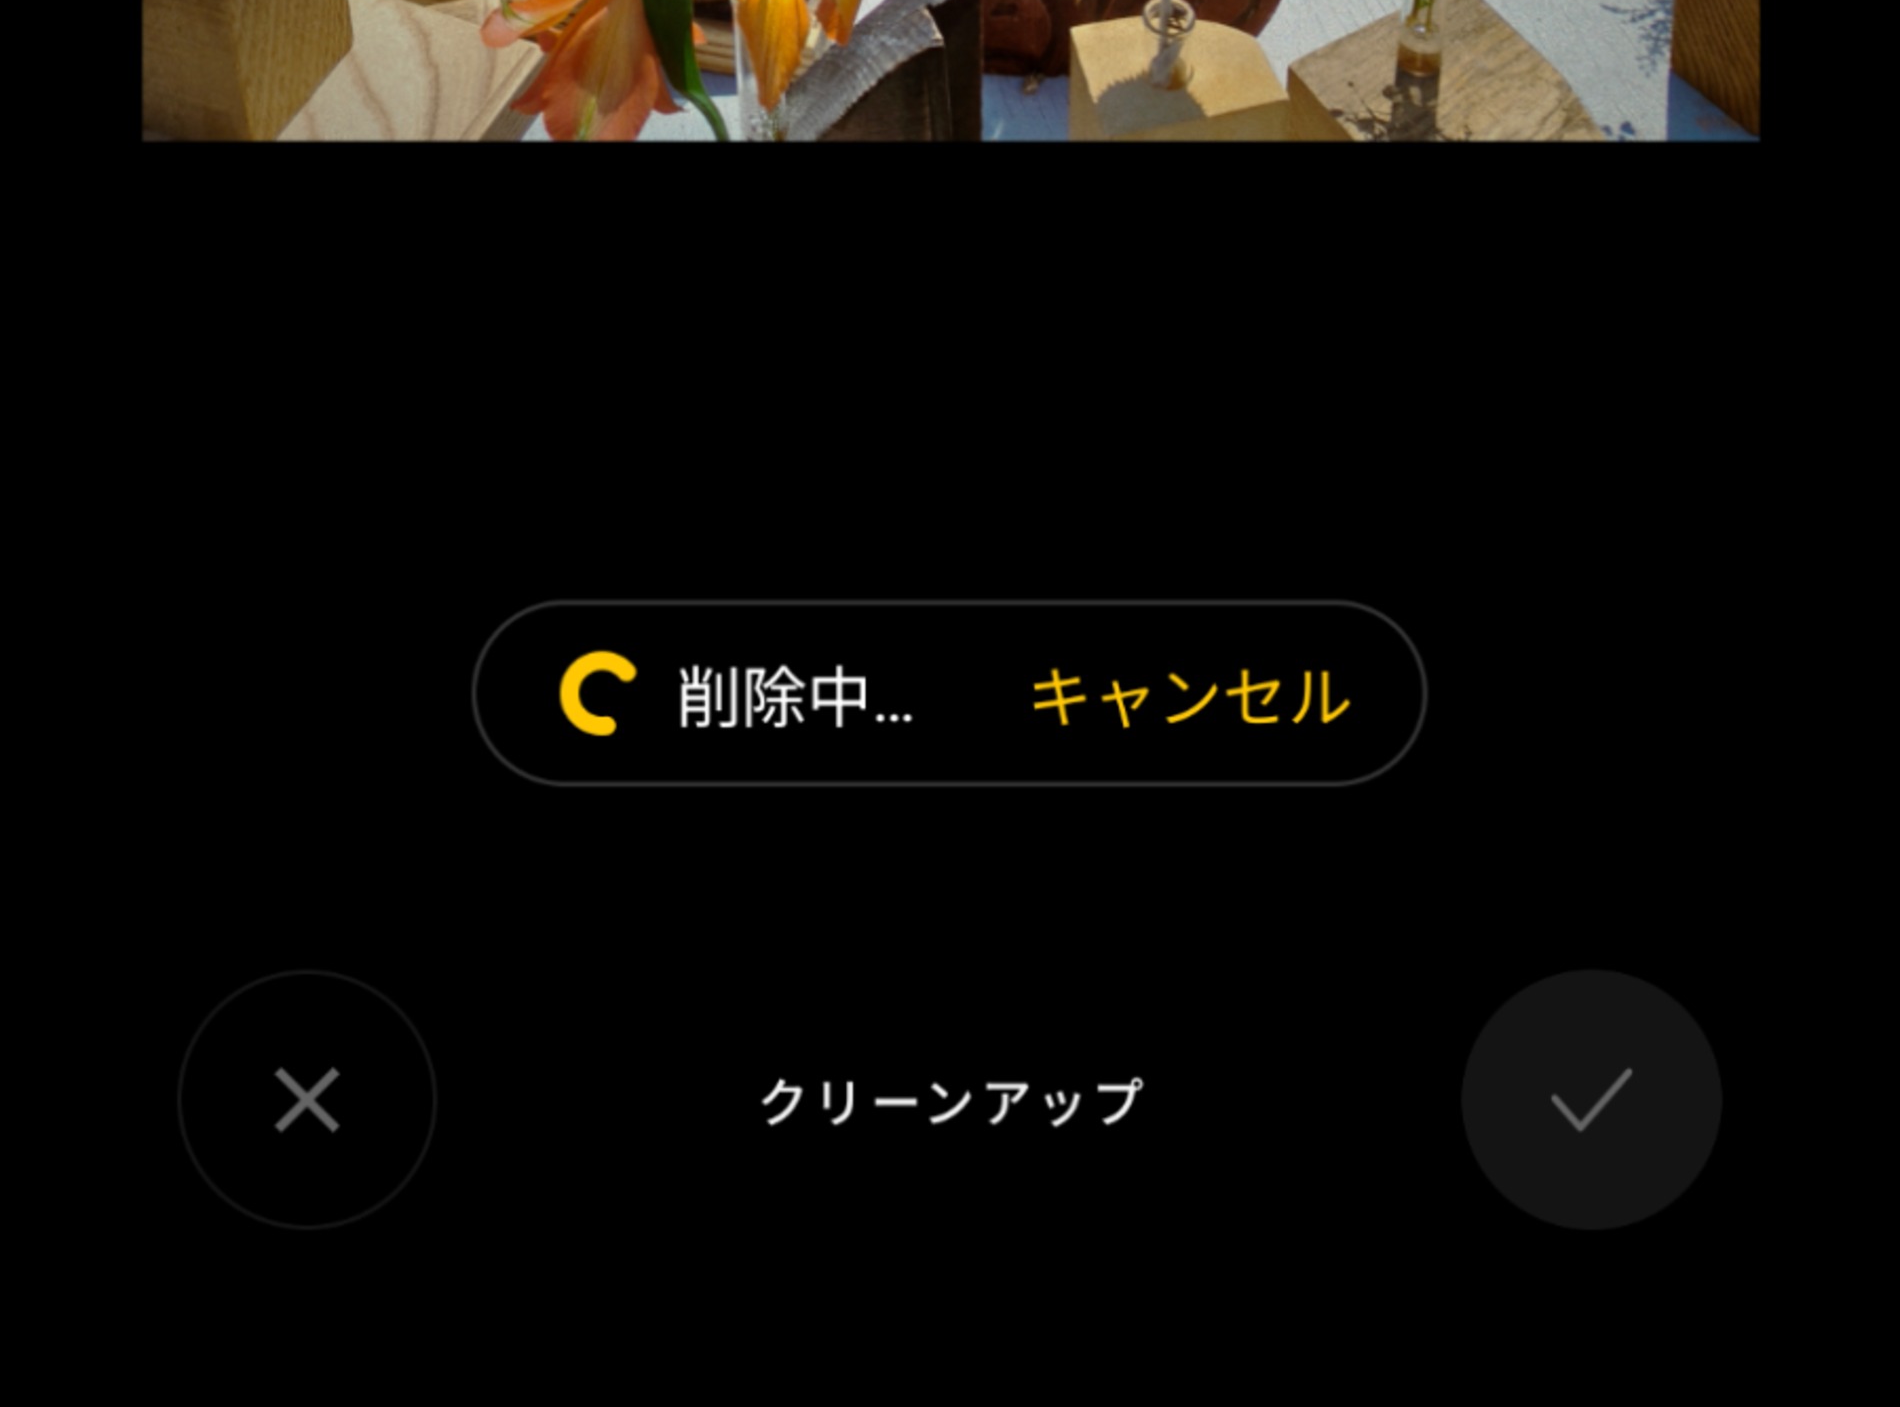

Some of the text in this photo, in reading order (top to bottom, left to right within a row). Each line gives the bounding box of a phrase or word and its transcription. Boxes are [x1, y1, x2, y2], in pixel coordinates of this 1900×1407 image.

[1034, 669, 1350, 728] キャンセル
[762, 1077, 1144, 1127] クリーンアップ
